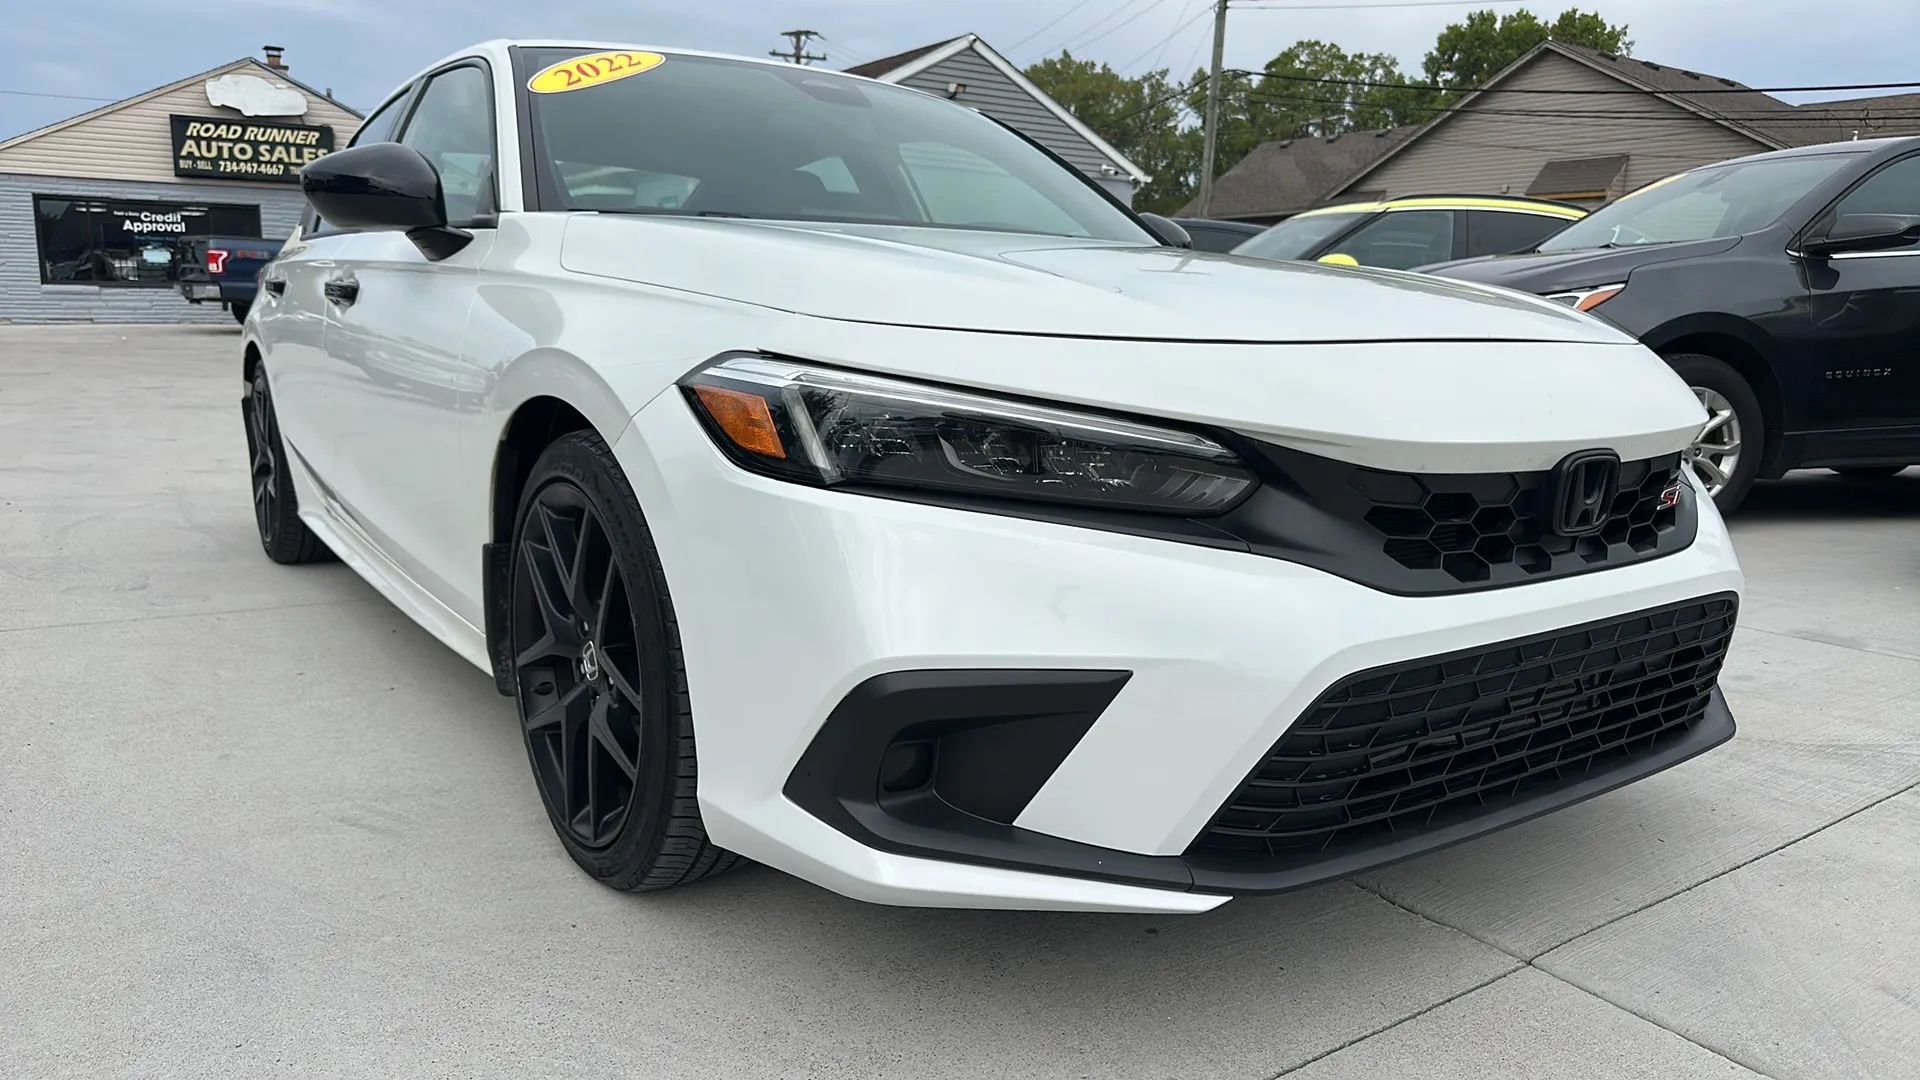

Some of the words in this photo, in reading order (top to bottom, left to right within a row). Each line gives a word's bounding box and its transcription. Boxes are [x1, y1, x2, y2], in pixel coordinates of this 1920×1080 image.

[554, 54, 641, 87] 2022
[186, 122, 243, 139] ROAD
[244, 126, 320, 145] RUNNER
[180, 139, 253, 161] AUTO
[179, 160, 192, 169] BUY
[197, 160, 213, 170] SELL
[218, 161, 284, 176] 734-947-4667
[140, 211, 181, 223] Credit
[122, 220, 186, 234] Approval
[1825, 367, 1892, 379] EQUINOX
